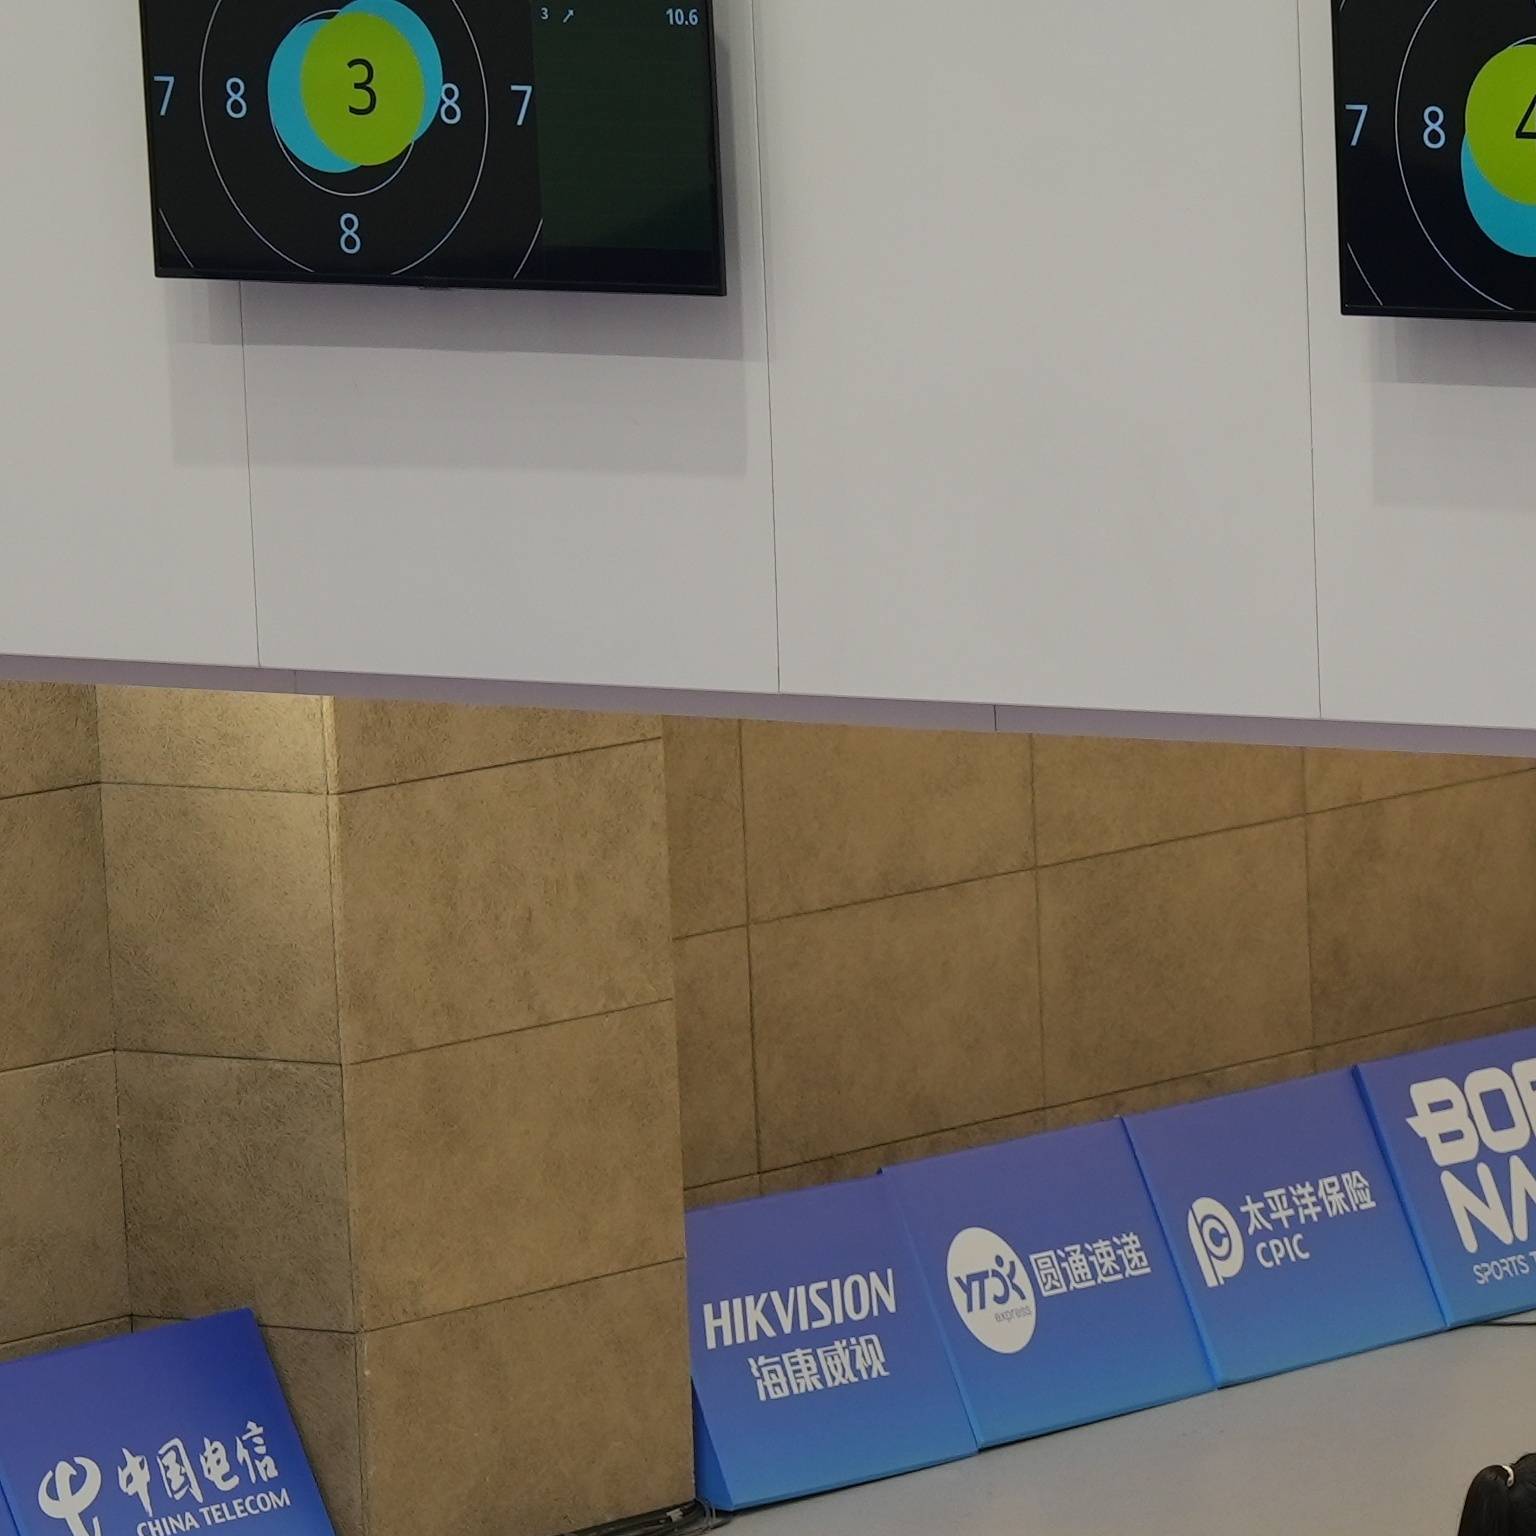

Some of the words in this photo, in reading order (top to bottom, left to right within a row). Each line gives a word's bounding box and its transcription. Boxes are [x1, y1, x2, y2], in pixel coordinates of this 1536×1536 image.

[540, 7, 549, 20] 3
[665, 8, 699, 26] 10.6
[153, 76, 175, 116] 7
[225, 77, 248, 119] 8
[346, 57, 378, 117] 3
[439, 83, 463, 125] 8
[510, 85, 533, 127] 7
[1345, 104, 1369, 147] 7
[1422, 106, 1446, 150] 8
[339, 213, 361, 255] 8
[1240, 1170, 1377, 1236] 太平洋保险
[1028, 1231, 1152, 1298] 圆通速递
[1255, 1233, 1311, 1268] CPIC
[1473, 1254, 1530, 1285] SPORTS
[703, 1268, 897, 1350] HIKVISION
[748, 1333, 891, 1402] 海康威视
[117, 1420, 279, 1517] 中国电信
[199, 1488, 291, 1526] TELECOM
